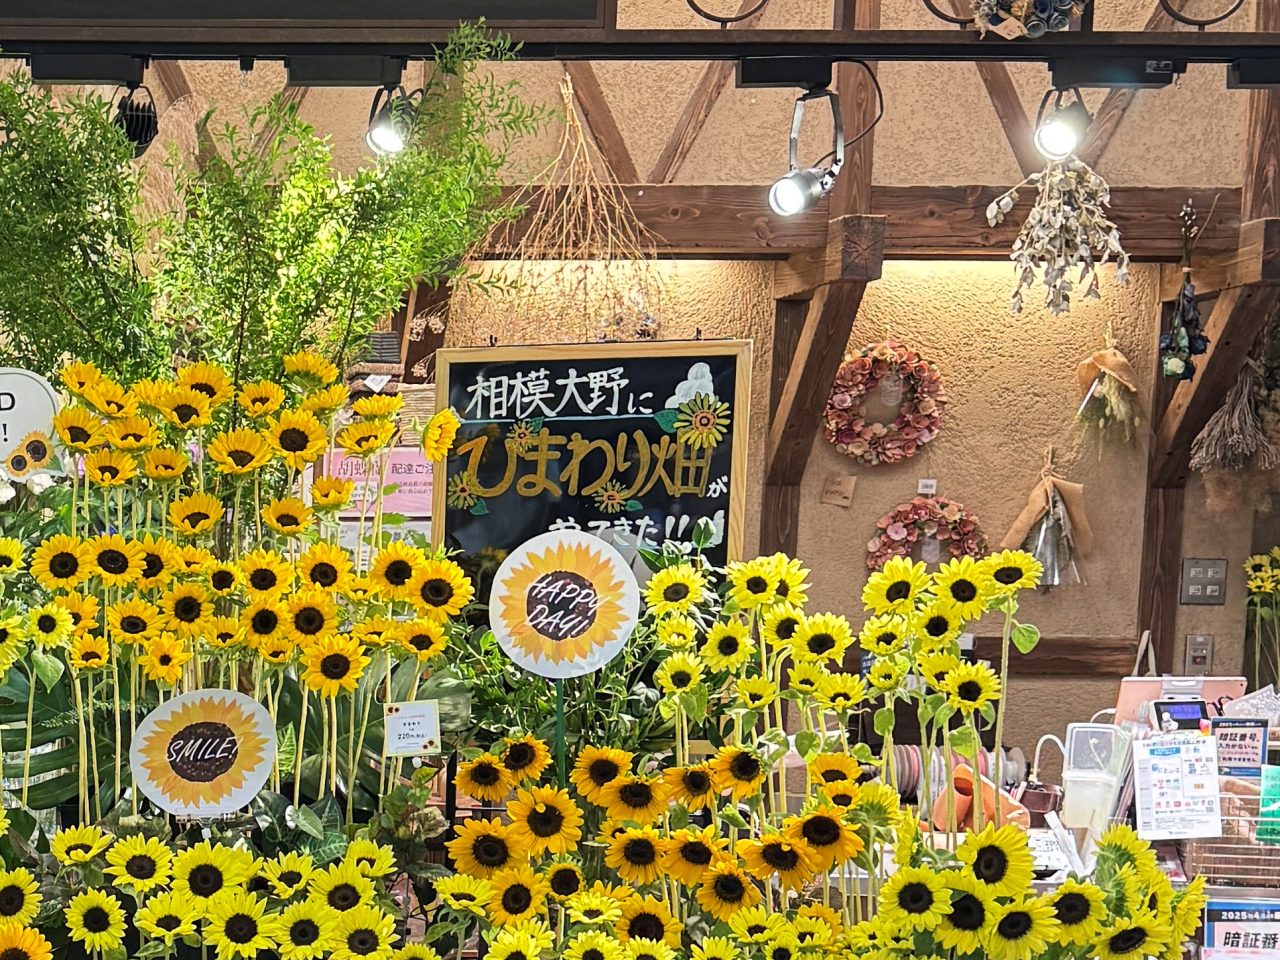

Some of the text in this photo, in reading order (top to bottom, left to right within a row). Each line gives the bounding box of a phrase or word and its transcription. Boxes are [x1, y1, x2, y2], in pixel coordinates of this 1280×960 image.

[465, 366, 654, 419] 相模大野に
[527, 576, 612, 616] HAPPY
[526, 604, 589, 639] DAY!
[168, 735, 244, 763] SMILE!
